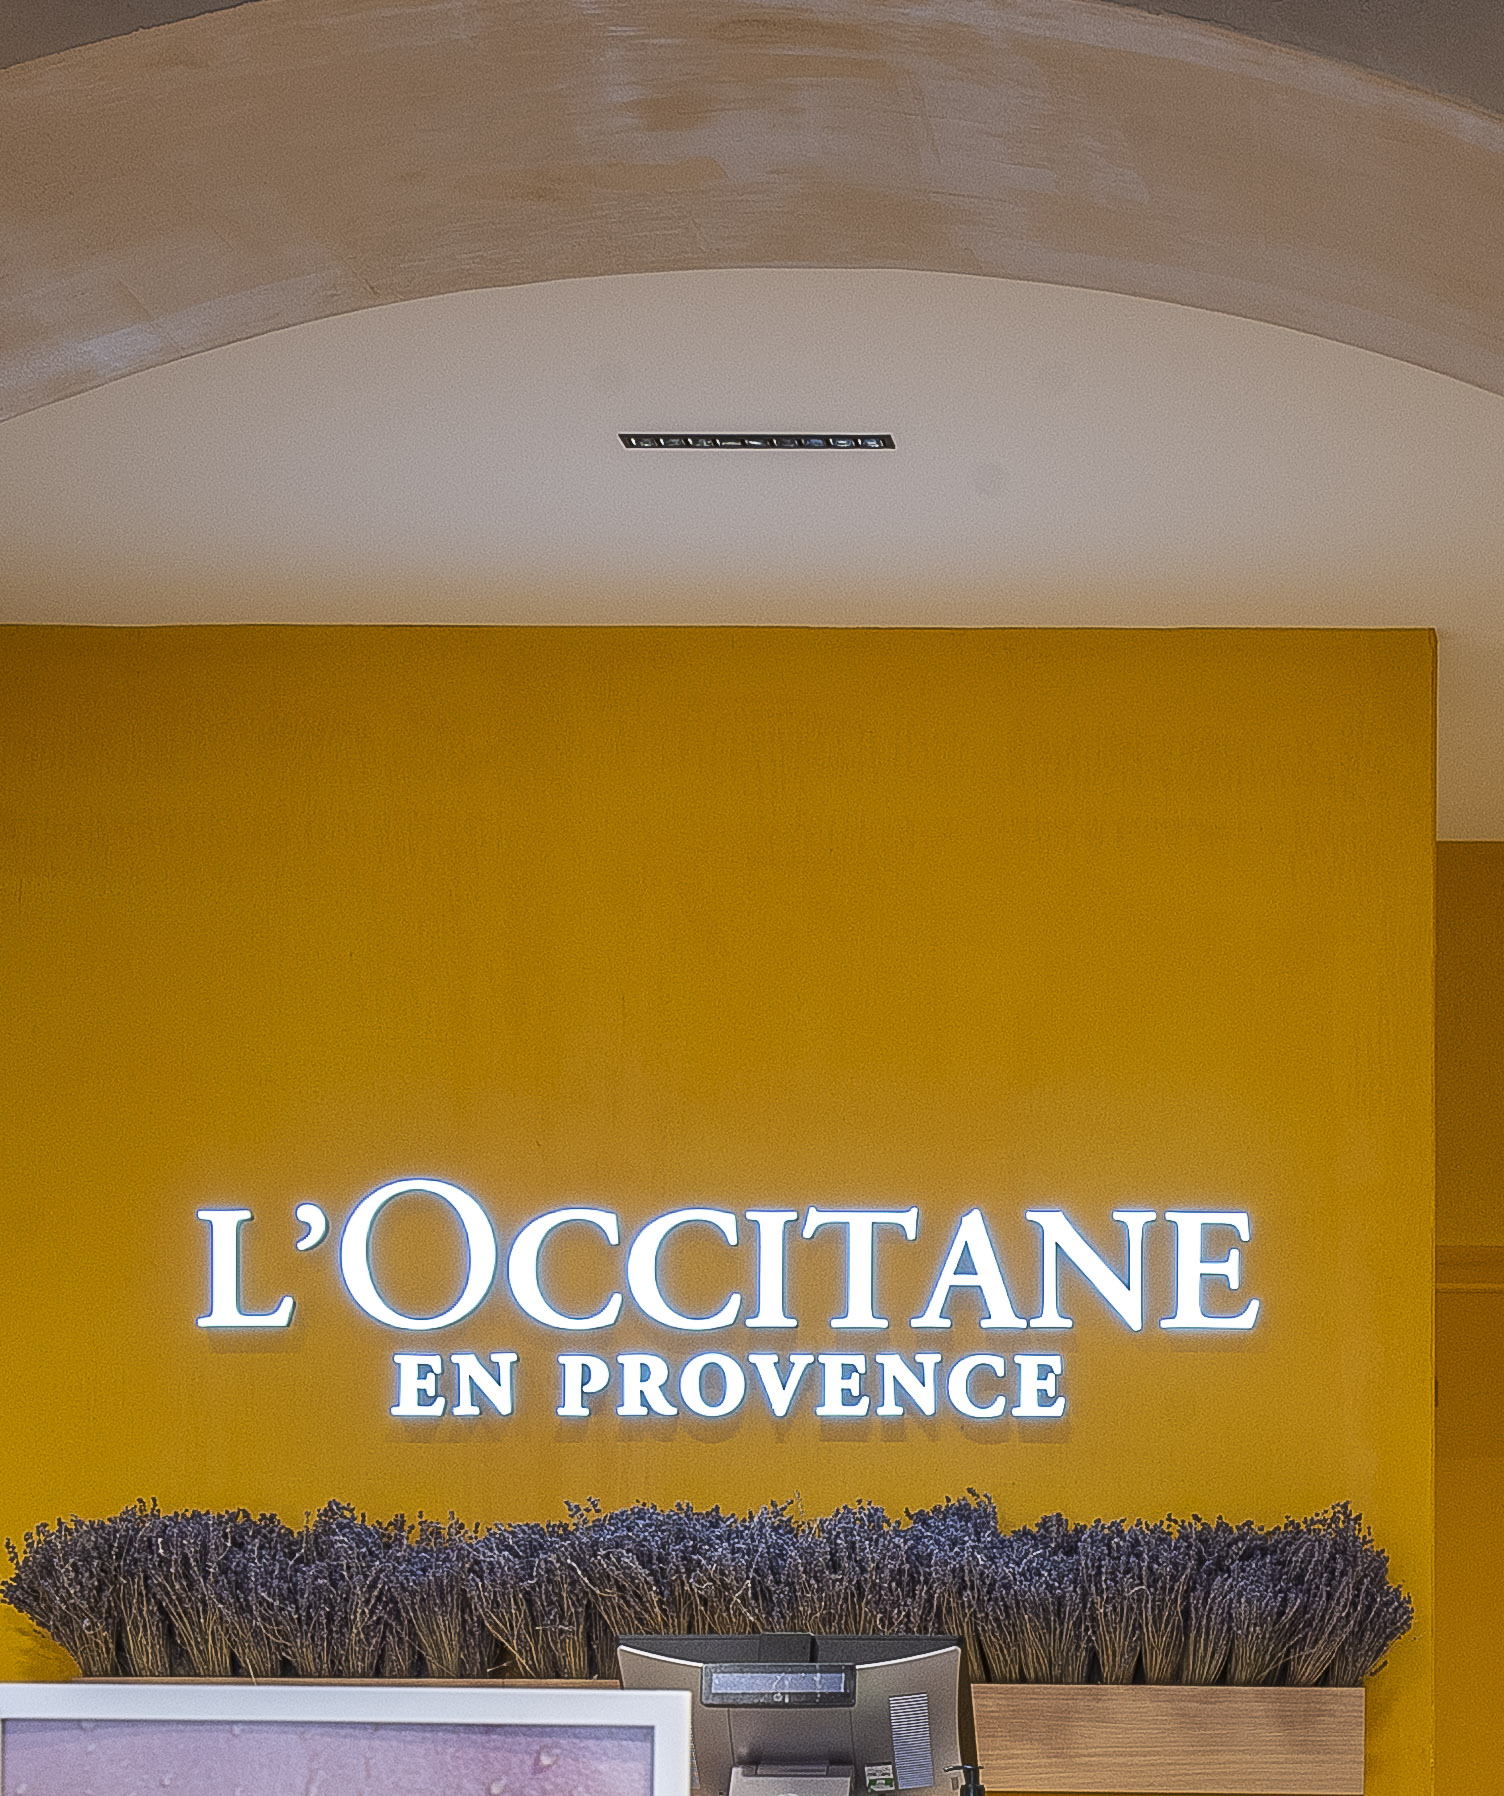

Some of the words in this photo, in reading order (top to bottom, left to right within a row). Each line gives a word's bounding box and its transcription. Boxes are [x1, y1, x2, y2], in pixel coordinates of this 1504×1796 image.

[195, 1178, 1261, 1333] L'OCCITANE
[389, 1351, 518, 1419] EN
[556, 1351, 1067, 1422] PROVENCE
